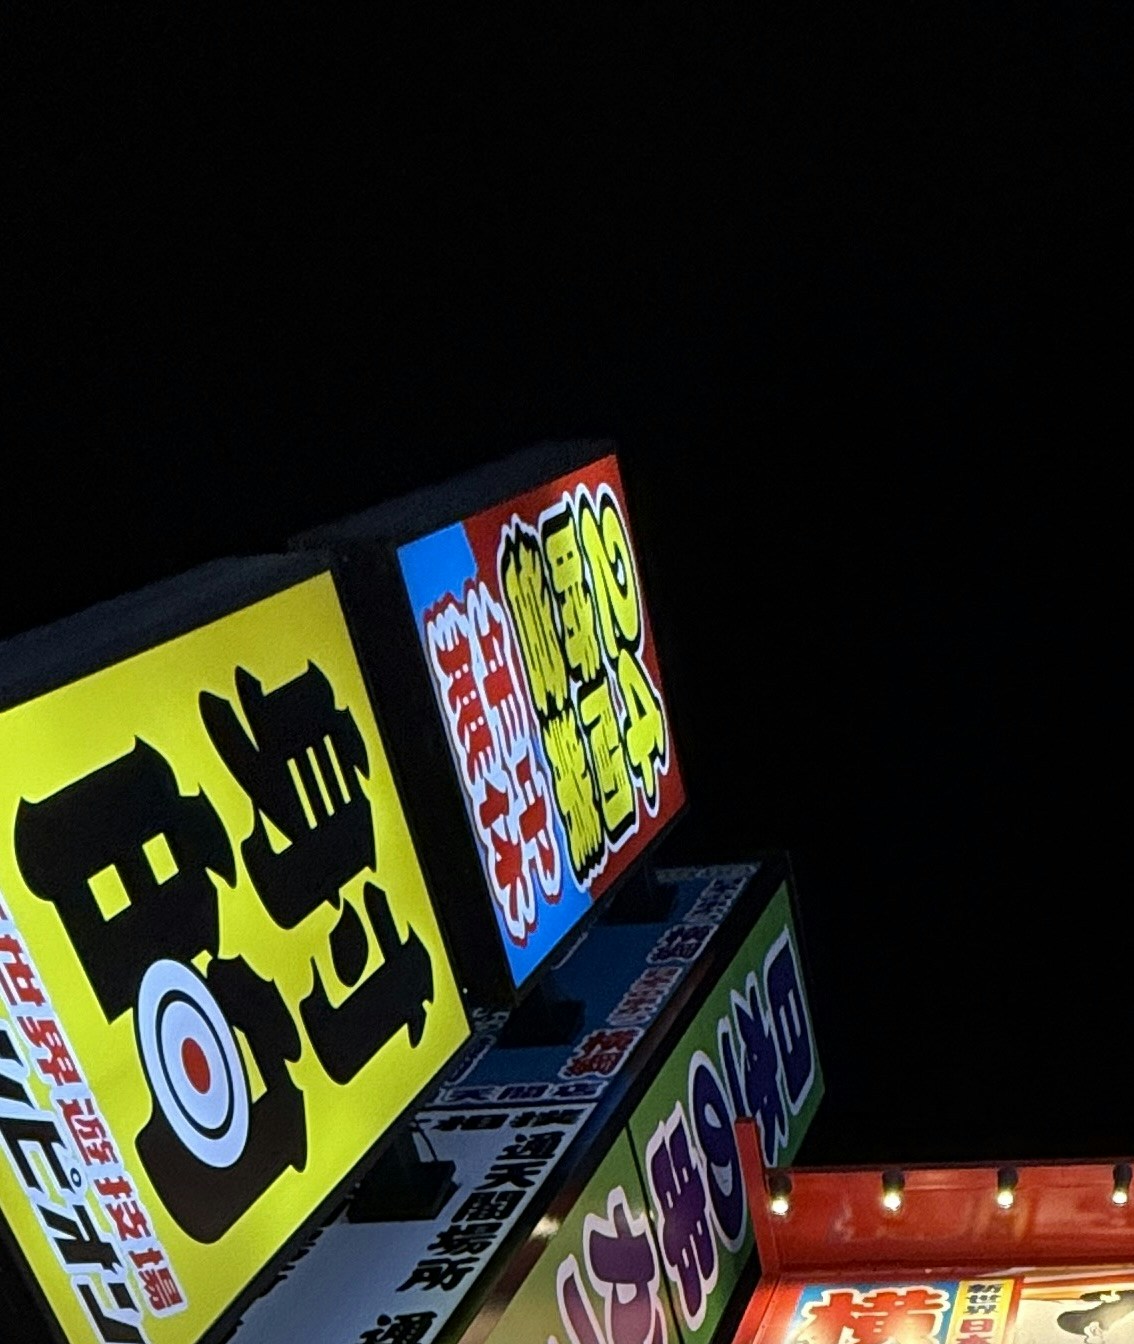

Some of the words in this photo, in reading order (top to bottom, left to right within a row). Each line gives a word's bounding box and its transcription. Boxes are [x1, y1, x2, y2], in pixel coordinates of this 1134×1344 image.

[426, 596, 539, 943] 無休
[467, 584, 560, 902] 年中
[500, 516, 608, 890] 営業
[541, 497, 640, 850] 時間
[577, 483, 670, 817] 24
[0, 903, 185, 1310] 世界遊技場
[14, 659, 434, 1243] 射的
